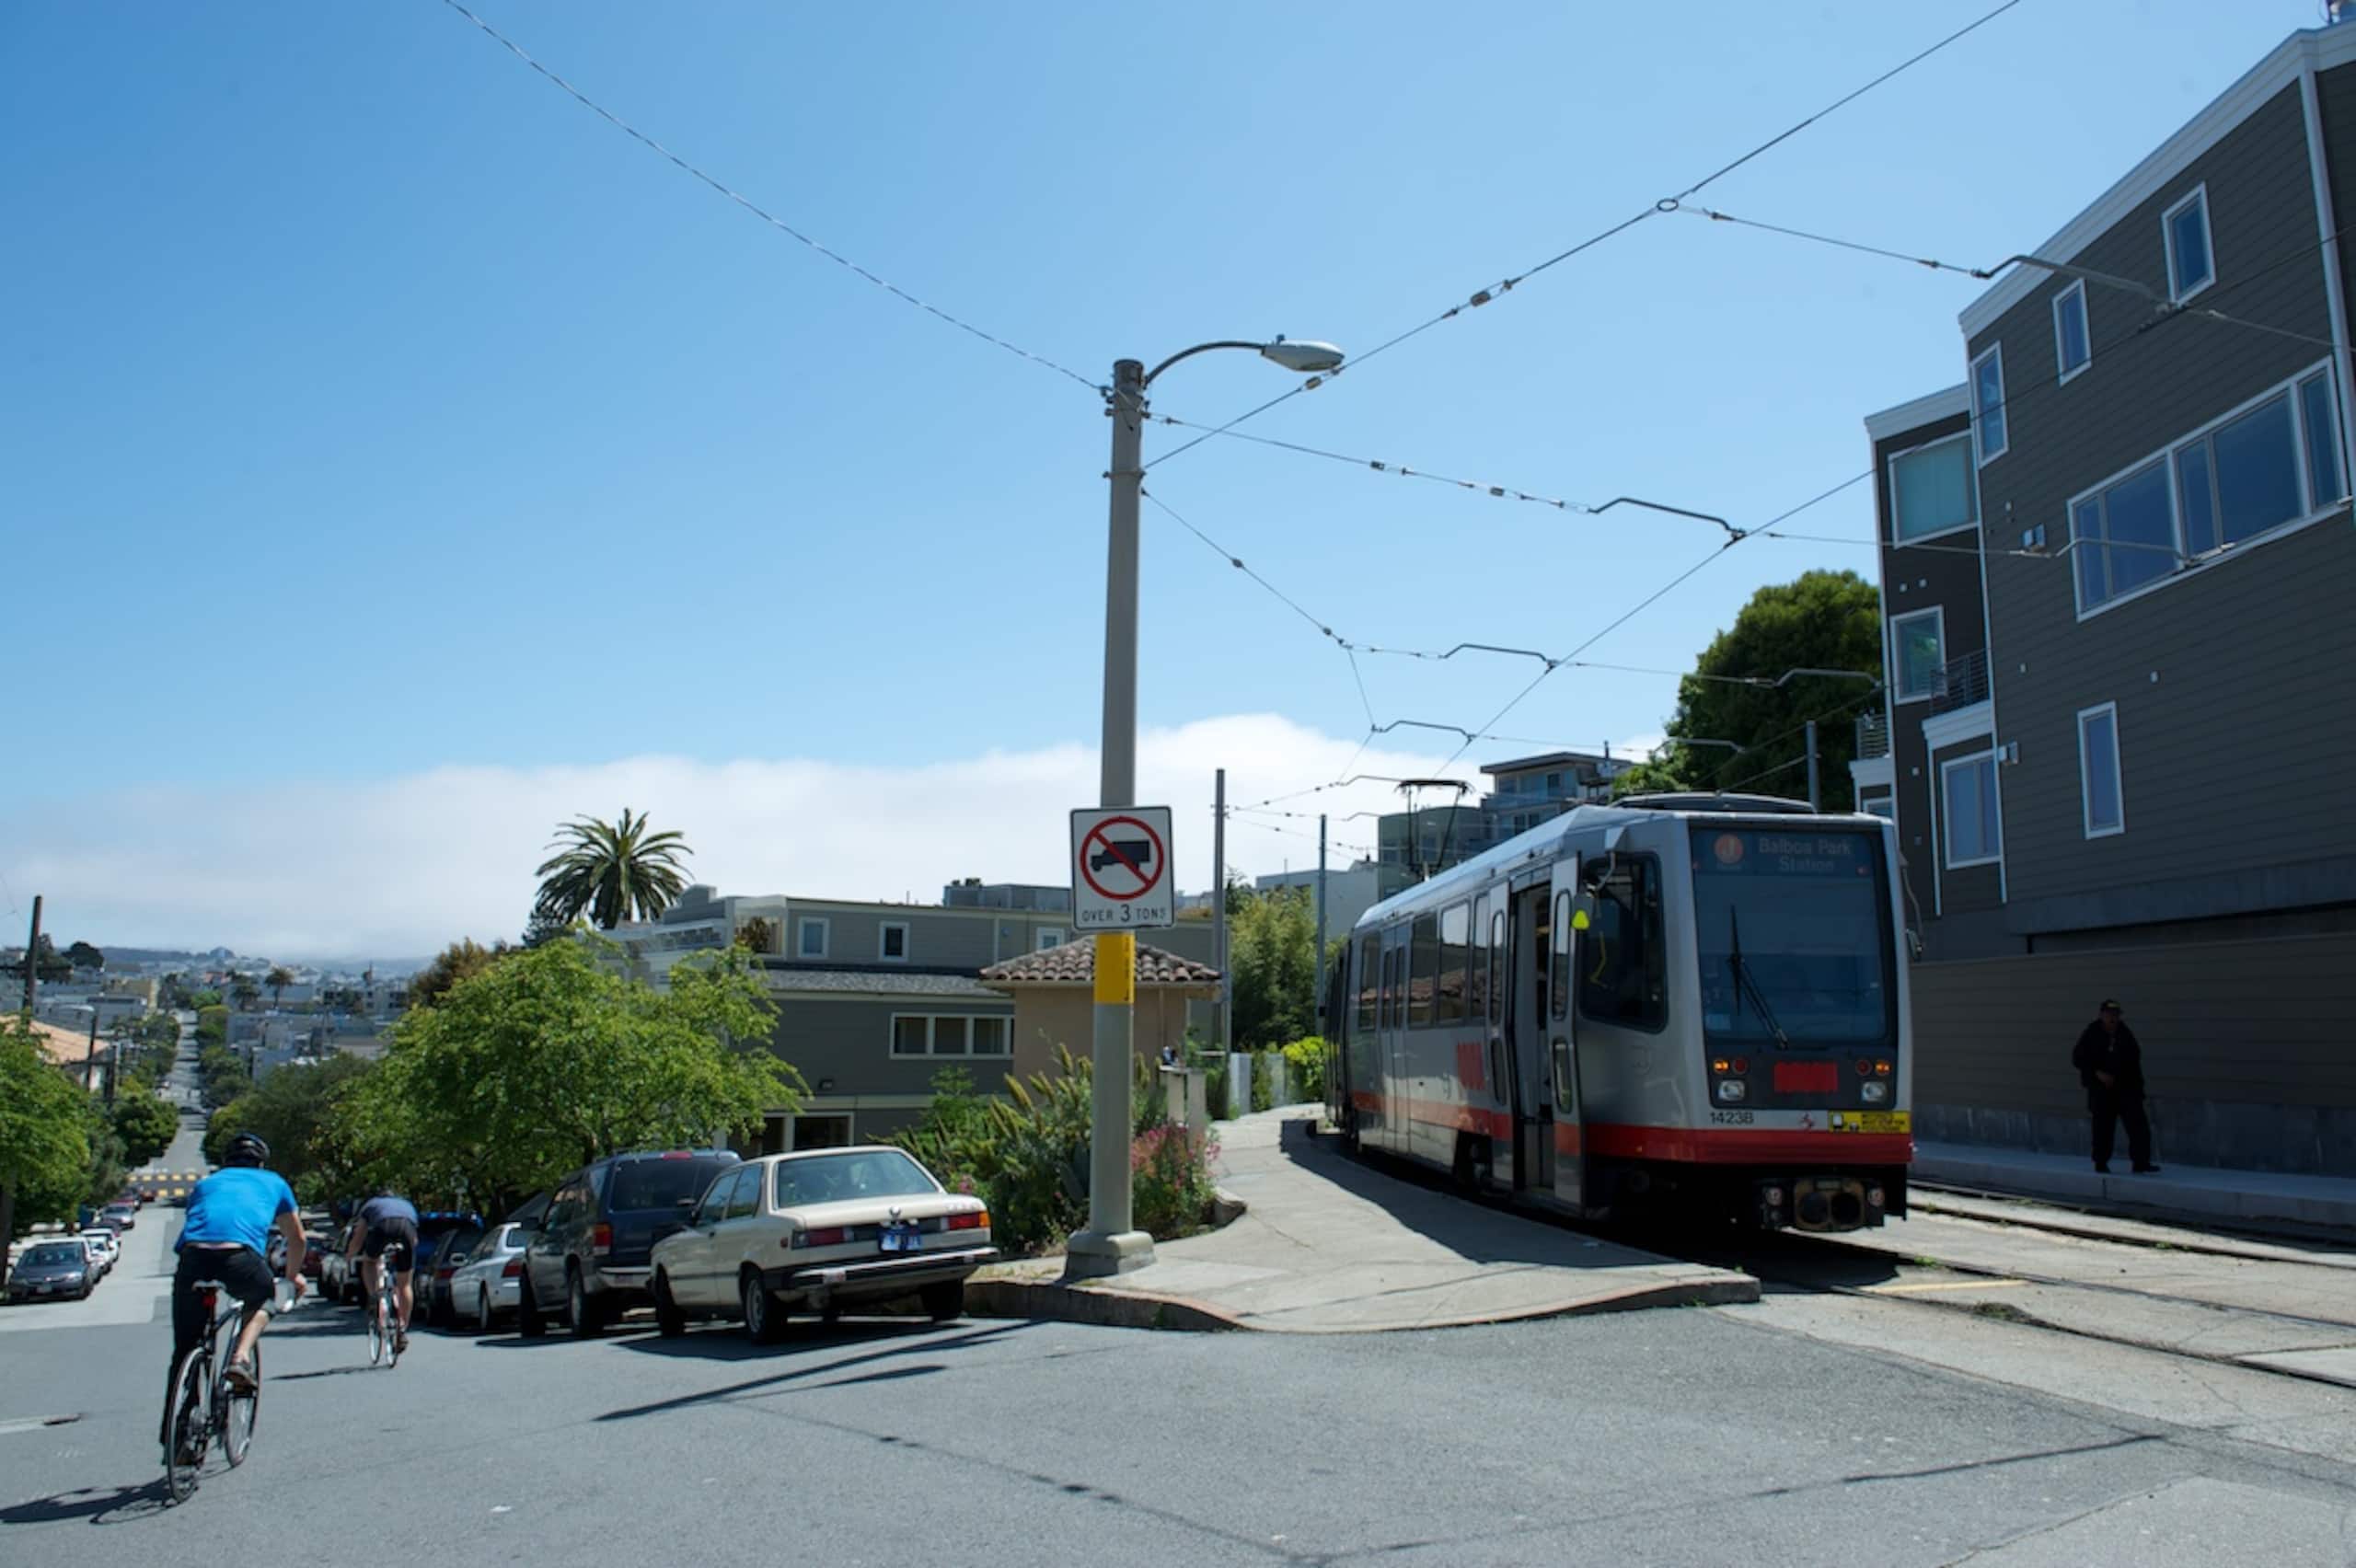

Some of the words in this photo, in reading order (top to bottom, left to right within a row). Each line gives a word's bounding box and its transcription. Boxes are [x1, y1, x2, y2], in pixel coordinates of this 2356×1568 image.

[1759, 837, 1812, 854] Balboa
[1819, 838, 1852, 854] Park
[1779, 856, 1834, 871] Station
[1081, 909, 1114, 921] OVER
[1119, 904, 1131, 922] 3
[1134, 907, 1167, 920] TONS
